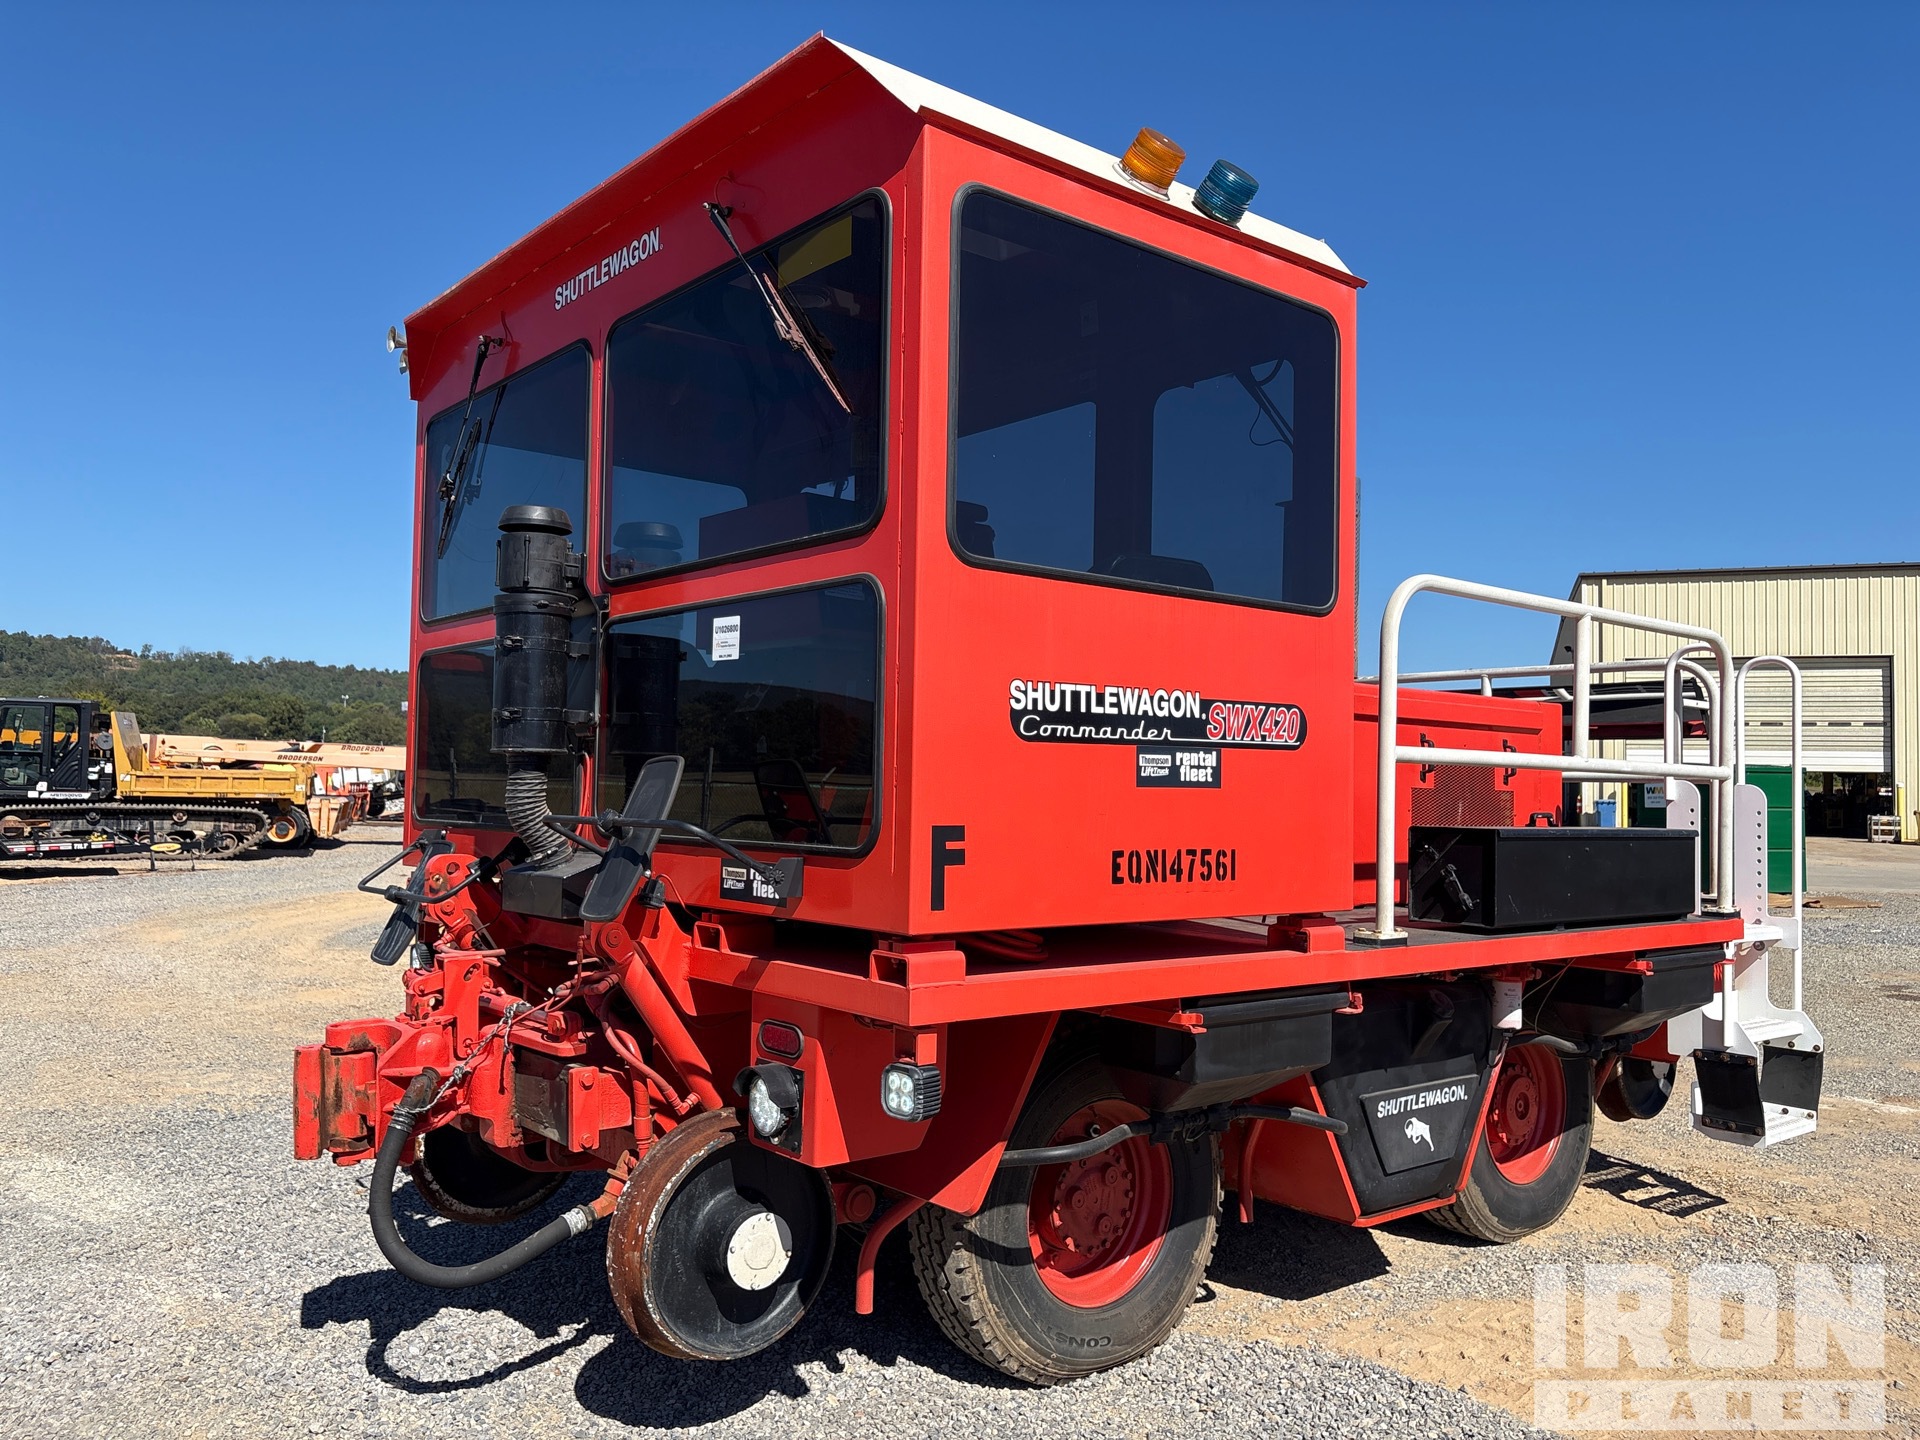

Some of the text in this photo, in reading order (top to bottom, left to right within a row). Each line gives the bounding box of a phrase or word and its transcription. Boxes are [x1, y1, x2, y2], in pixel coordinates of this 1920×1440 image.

[554, 226, 660, 311] SHUTTLEWAGON
[1009, 679, 1200, 719] SHUTTLEWAGON
[1019, 714, 1172, 741] Commander
[1206, 702, 1300, 743] SWX420
[341, 743, 386, 753] BRODERSON
[277, 754, 324, 762] BRODERSON
[1140, 755, 1170, 766] Thompson
[1175, 750, 1217, 767] rental
[1179, 764, 1214, 782] fleet
[1645, 786, 1664, 795] WM
[73, 842, 89, 850] TILT
[724, 868, 746, 879] Thompson
[930, 825, 966, 911] F
[1110, 849, 1237, 885] EQN147561
